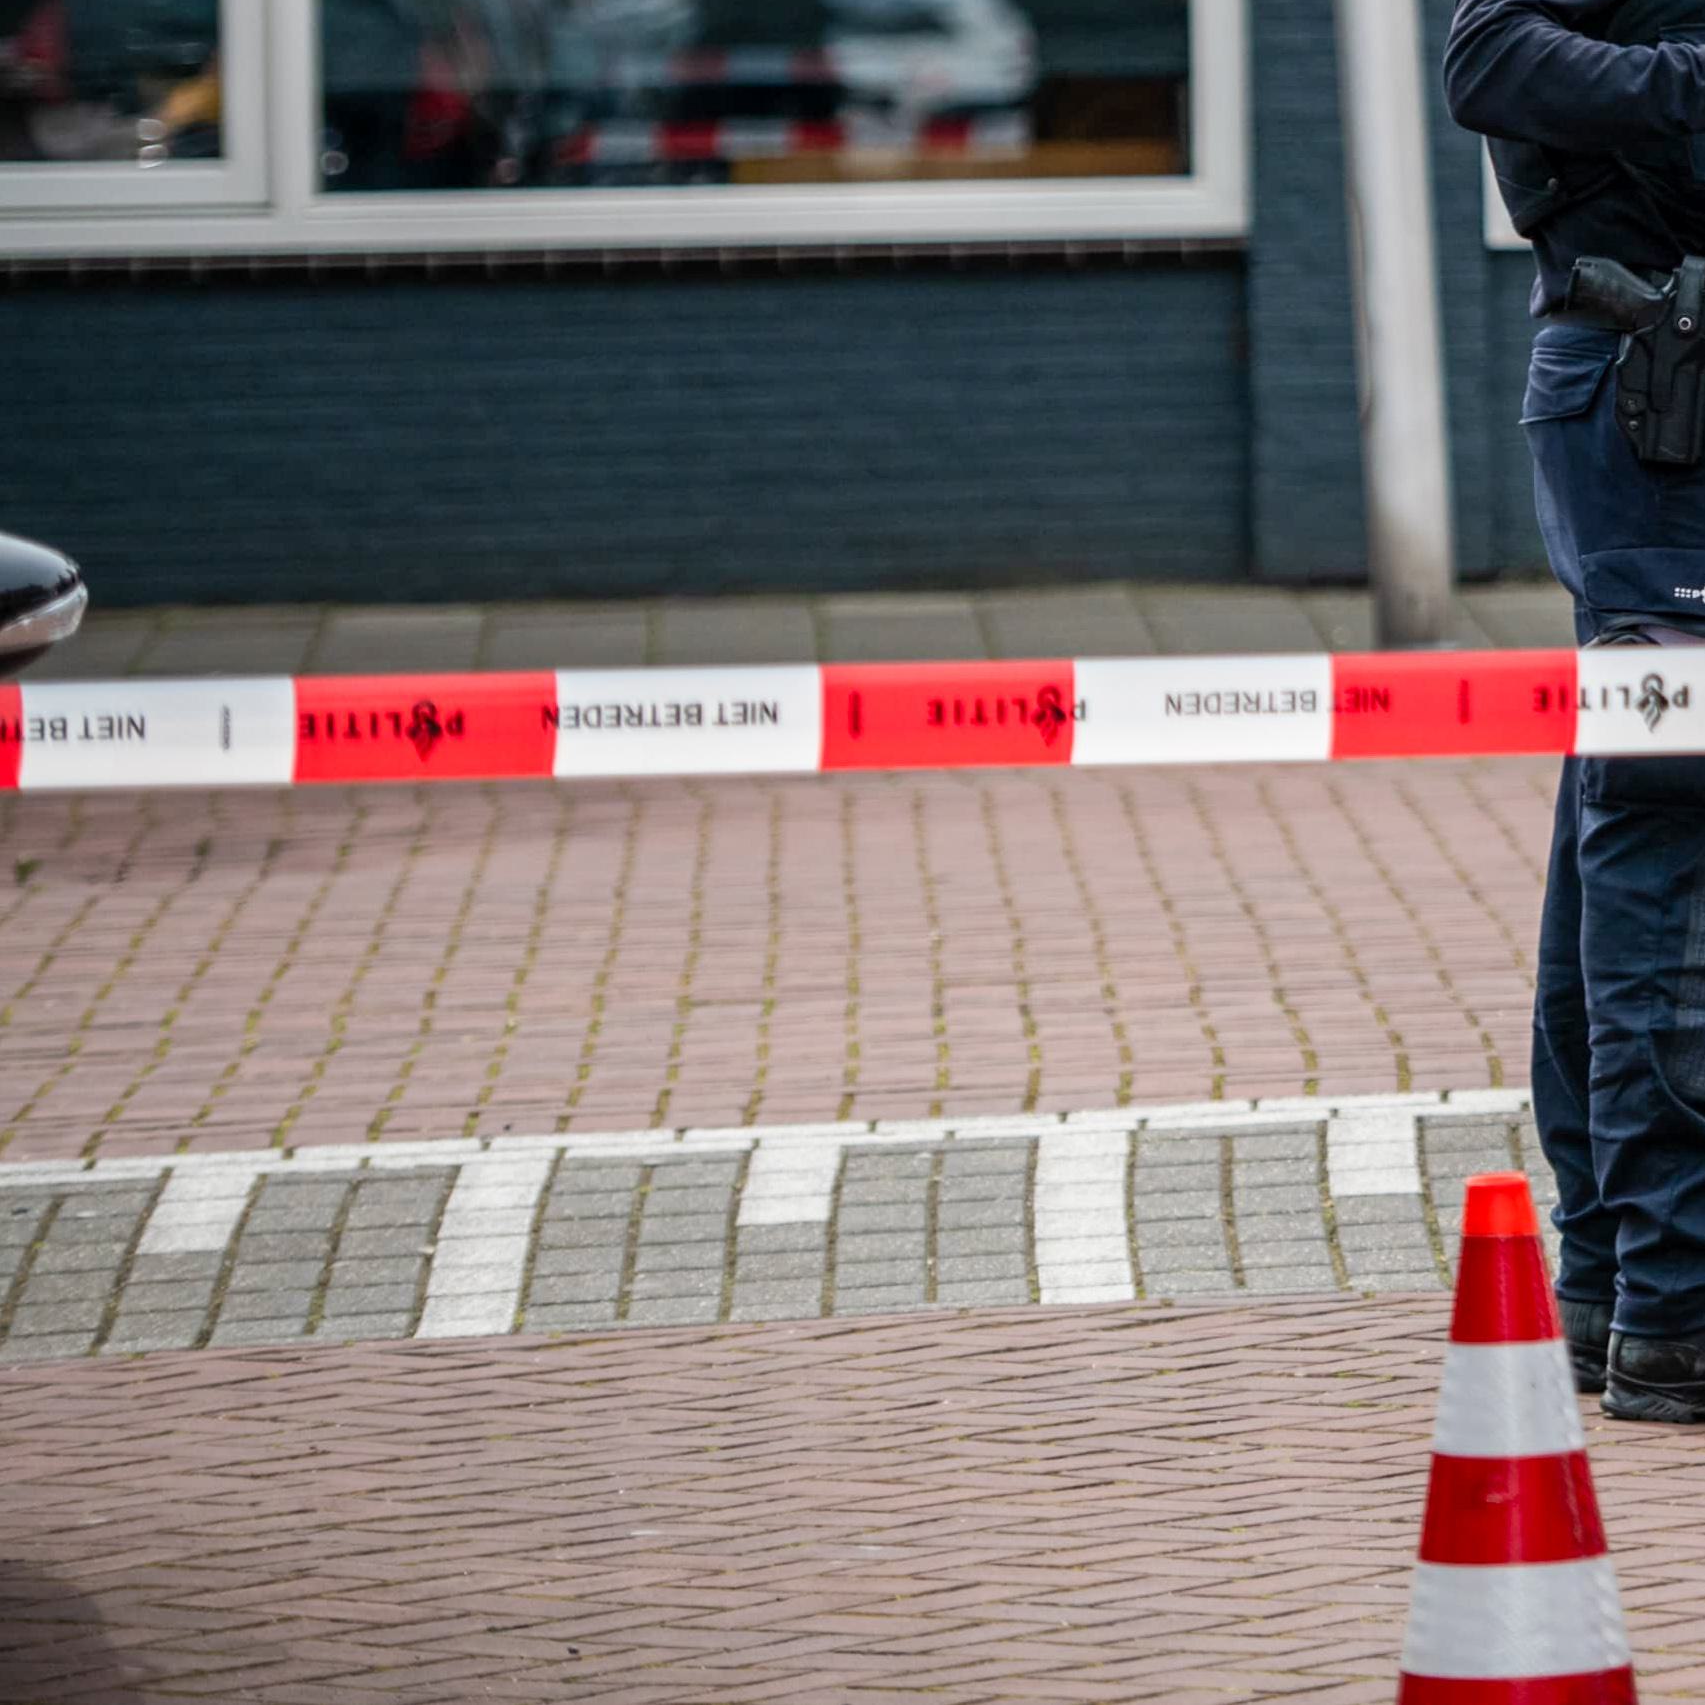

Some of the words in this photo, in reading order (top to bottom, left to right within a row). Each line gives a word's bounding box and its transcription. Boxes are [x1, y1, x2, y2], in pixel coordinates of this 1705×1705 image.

[1165, 691, 1317, 717] BETREDEN
[1533, 672, 1691, 713] POLITIE
[541, 703, 703, 731] BETREDEN
[711, 702, 779, 727] NIET
[77, 716, 146, 741] NIET
